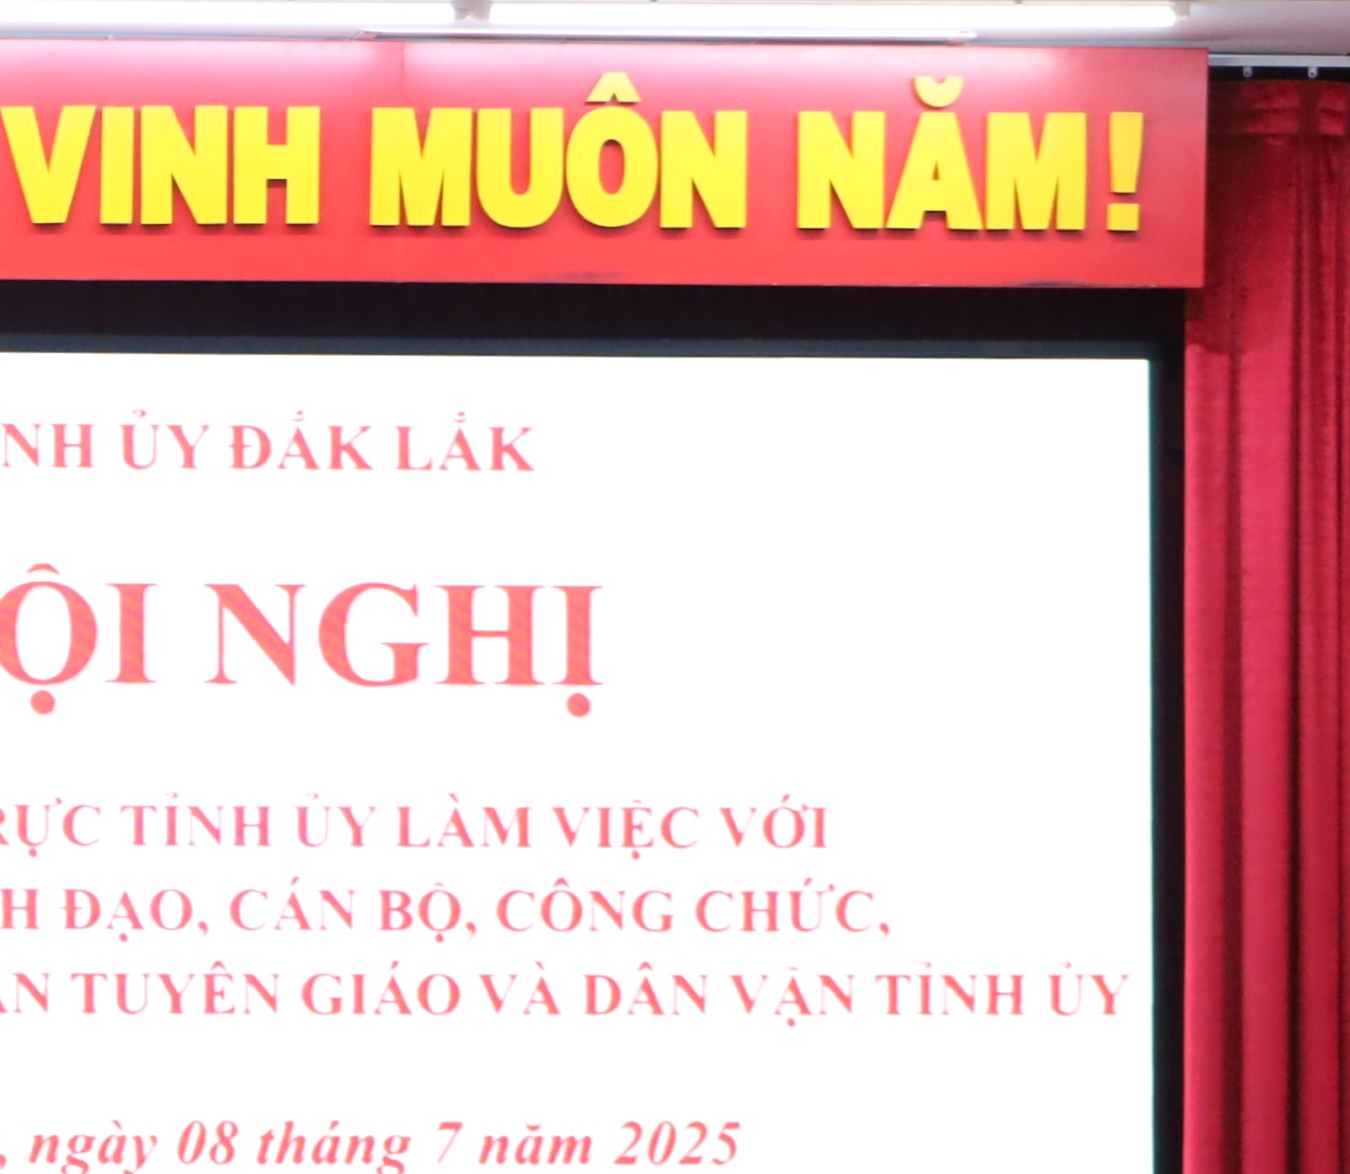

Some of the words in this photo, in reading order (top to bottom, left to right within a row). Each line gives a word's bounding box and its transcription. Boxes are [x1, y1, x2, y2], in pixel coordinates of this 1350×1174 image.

[0, 105, 321, 226] VINH
[369, 71, 749, 229] MUÔN
[120, 409, 210, 471] ỦY
[229, 409, 373, 471] ĐẮK
[396, 411, 534, 472] LẮK
[203, 581, 603, 719] NGHỊ
[119, 792, 271, 847] TỈNH
[296, 793, 376, 848] ỦY
[396, 792, 532, 849] LÀM
[551, 799, 700, 861] VIỆC
[719, 793, 827, 849] VỚI
[63, 888, 210, 944] ĐẠO,
[228, 875, 356, 932] CÁN
[379, 882, 478, 944] BỘ,
[495, 876, 674, 933] CÔNG
[694, 876, 891, 939] CHỨC,
[70, 959, 279, 1016] TUYÊN
[300, 959, 462, 1016] GIÁO
[479, 960, 561, 1016] VÀ
[584, 960, 708, 1017] DÂN
[730, 967, 854, 1028] VẬN
[874, 961, 1024, 1016] TỈNH
[1048, 961, 1129, 1017] ỦY
[176, 1119, 240, 1166] 08
[435, 1120, 464, 1165] 7
[478, 1123, 593, 1166] năm
[613, 1120, 741, 1167] 2025
